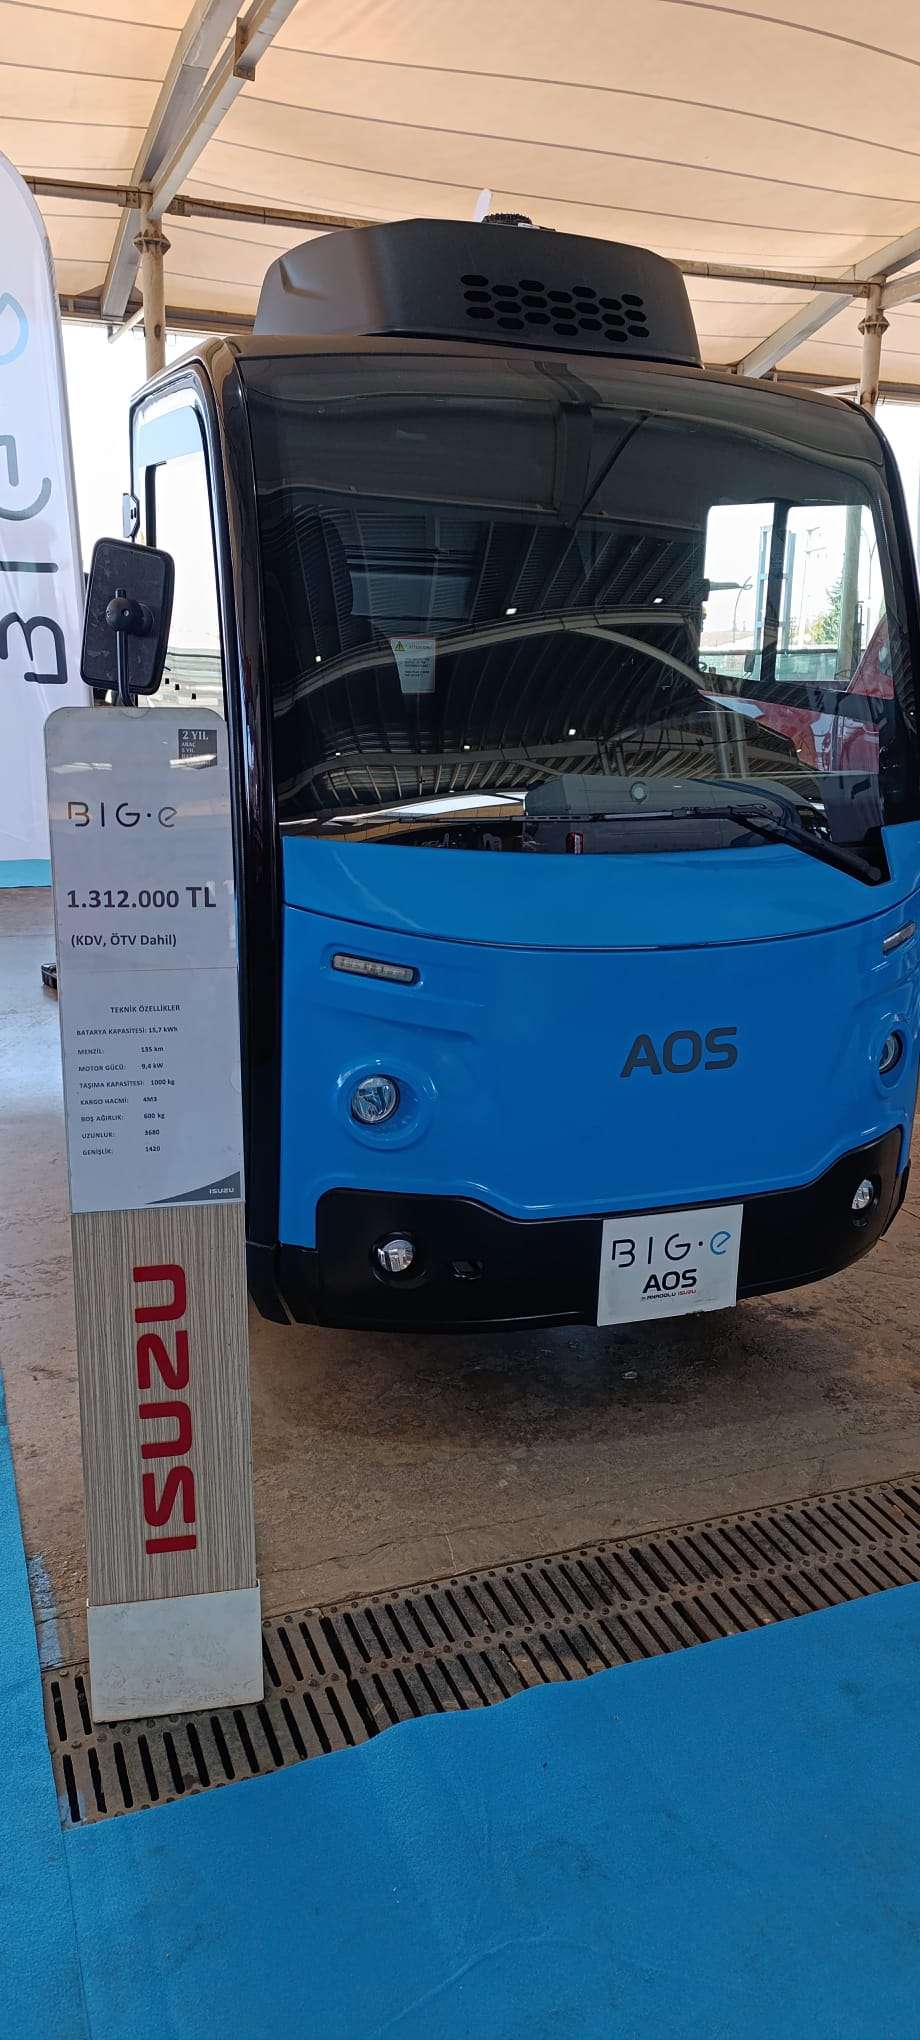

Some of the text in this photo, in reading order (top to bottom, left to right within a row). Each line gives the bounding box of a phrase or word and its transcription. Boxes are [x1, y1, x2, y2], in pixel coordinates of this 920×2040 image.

[182, 730, 209, 740] 2 YIL
[67, 886, 217, 908] 1.312.000 TL
[71, 933, 177, 947] (KDV, ÖTV Dahil)
[110, 1004, 180, 1013] TEKNİK ÖZELLİKLER
[620, 1026, 738, 1078] AOS
[80, 1082, 105, 1090] TAŞIMA
[168, 1078, 175, 1086] kg
[209, 1186, 235, 1195] ISUZU
[642, 1269, 698, 1294] AOS
[132, 1263, 198, 1555] ISUZU
